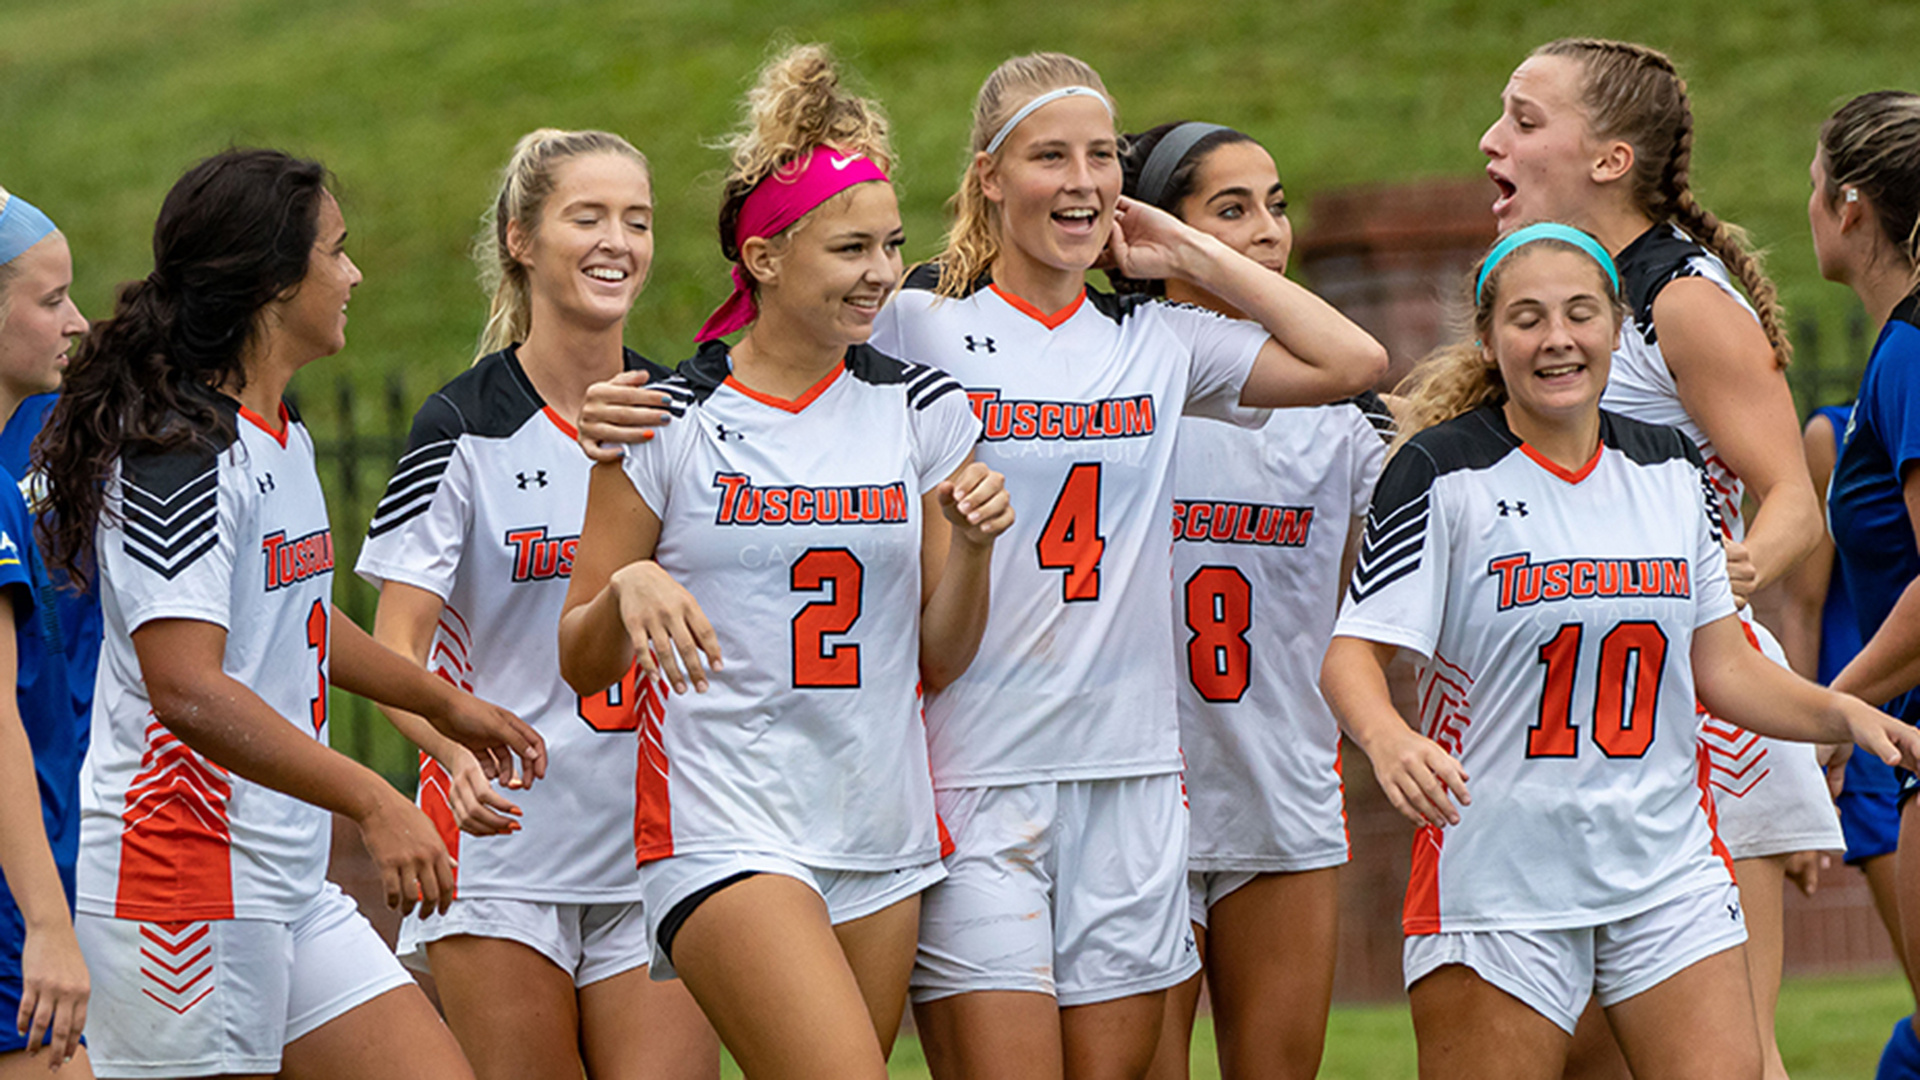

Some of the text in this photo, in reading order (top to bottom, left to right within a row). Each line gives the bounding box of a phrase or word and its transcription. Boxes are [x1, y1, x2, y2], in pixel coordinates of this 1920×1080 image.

[712, 471, 909, 526] TUSCULUM
[1036, 462, 1106, 602] 4
[1173, 499, 1315, 547] SCULUM
[790, 547, 864, 689] 2
[1184, 565, 1252, 703] 8
[1487, 552, 1691, 612] TUSCULUM
[1525, 621, 1668, 759] 10
